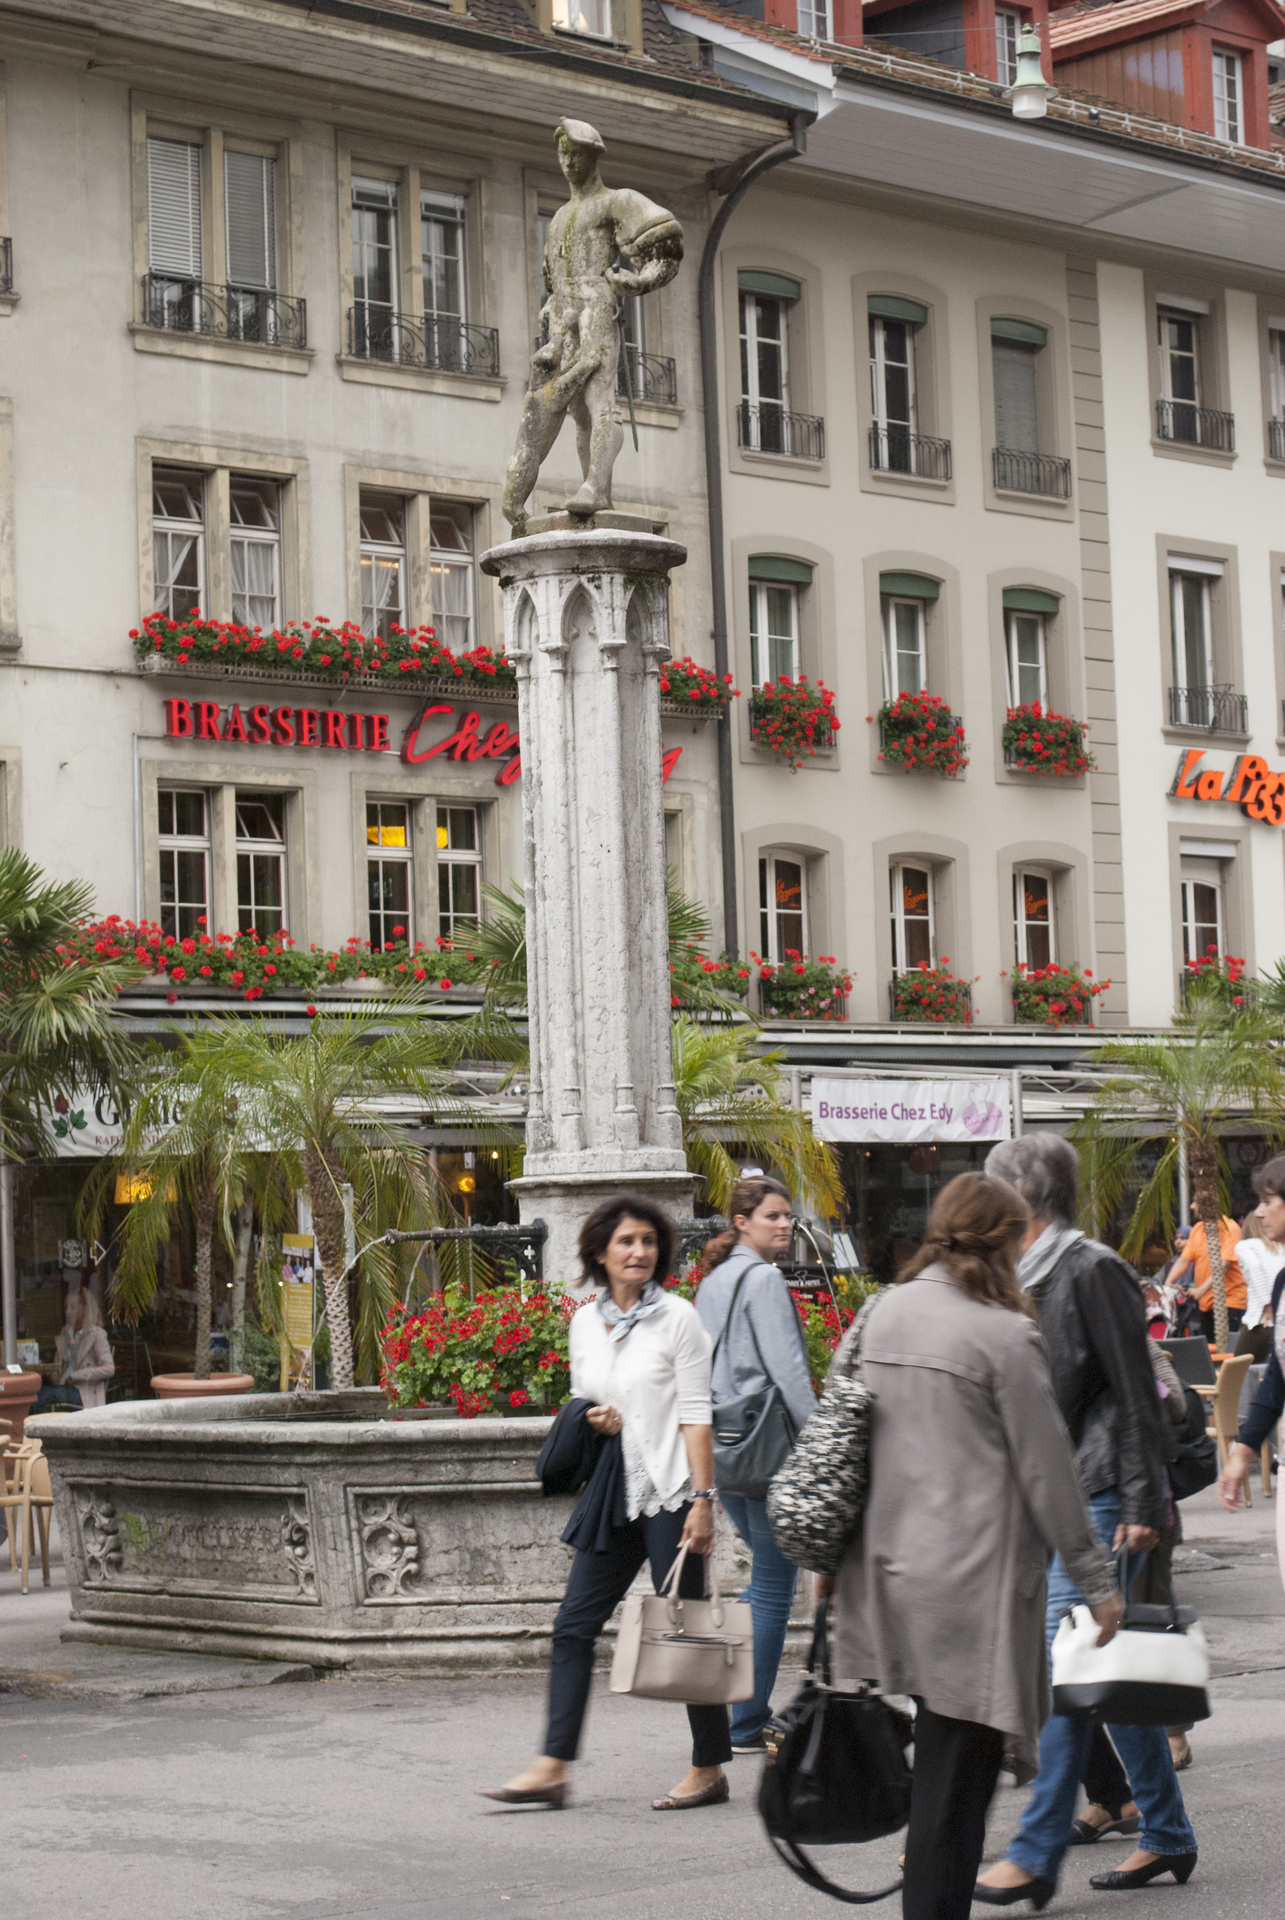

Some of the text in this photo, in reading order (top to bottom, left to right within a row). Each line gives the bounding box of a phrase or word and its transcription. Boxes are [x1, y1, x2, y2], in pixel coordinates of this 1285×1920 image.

[165, 698, 391, 750] BRASSERIE
[1171, 749, 1225, 800] La
[819, 1101, 888, 1120] Brasserie
[891, 1102, 927, 1121] Chez
[930, 1103, 953, 1125] Edy
